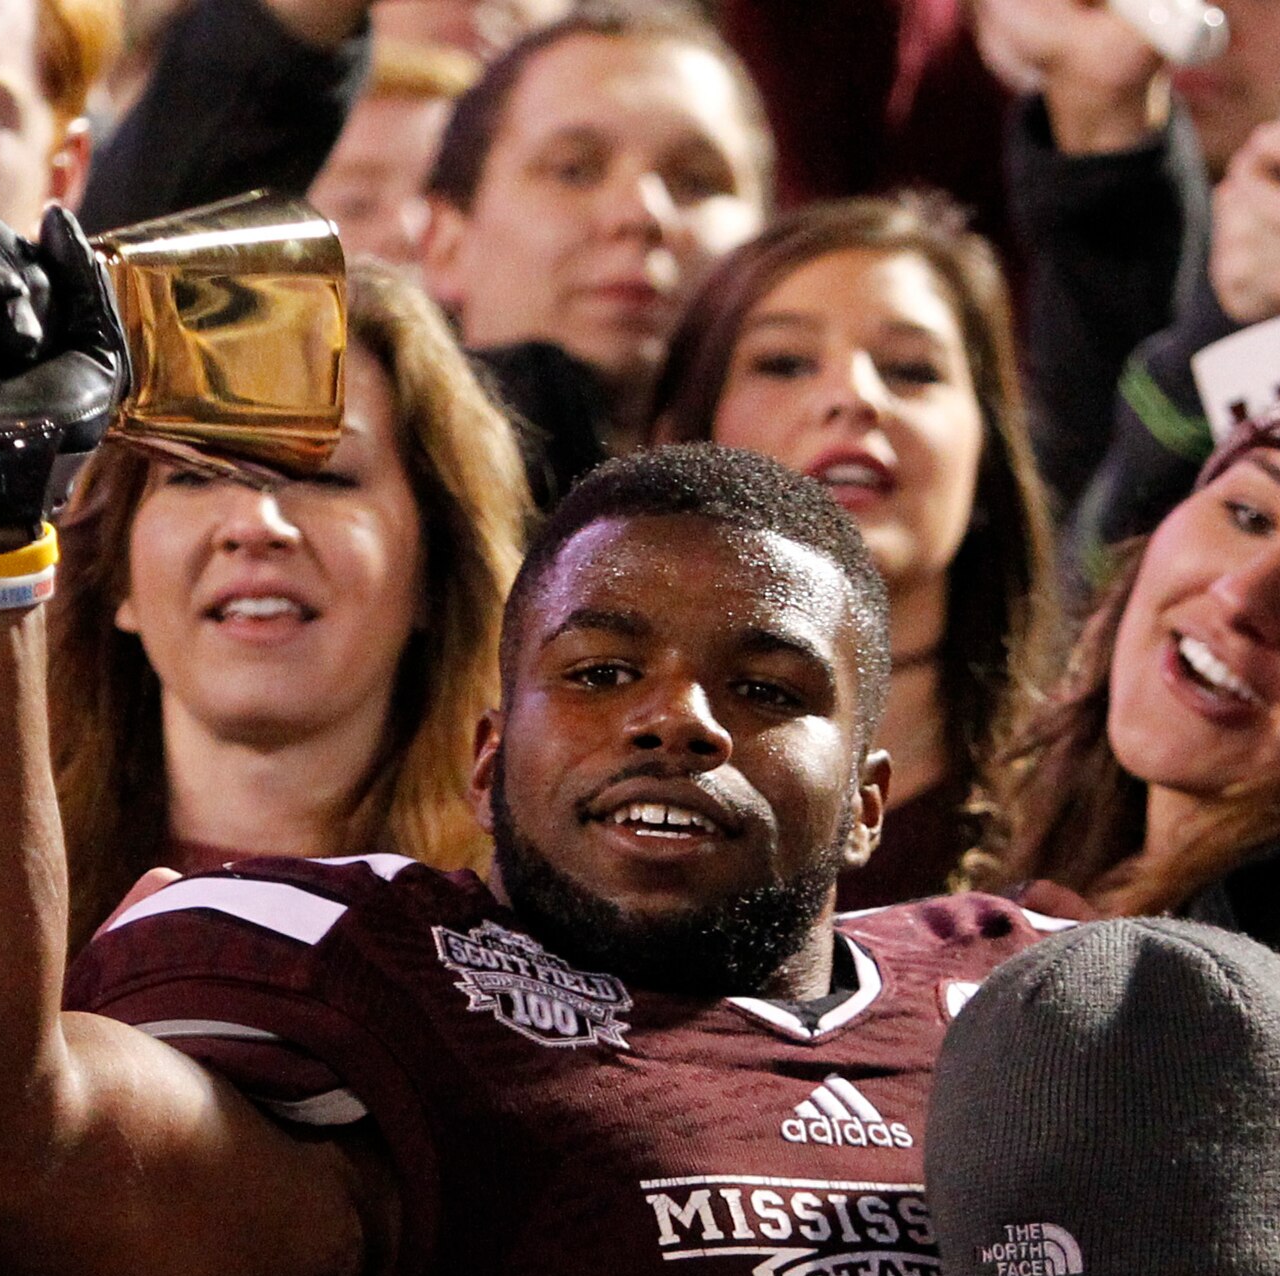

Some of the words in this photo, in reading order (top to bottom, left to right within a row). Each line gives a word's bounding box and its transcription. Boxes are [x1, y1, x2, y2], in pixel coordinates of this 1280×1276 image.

[447, 936, 532, 977] SCOTT
[532, 963, 618, 1002] FIELD
[509, 989, 579, 1037] 100
[781, 1113, 914, 1149] adidas
[645, 1188, 939, 1246] MISSISS
[1003, 1222, 1041, 1242] THE
[981, 1241, 1043, 1263] NORTH
